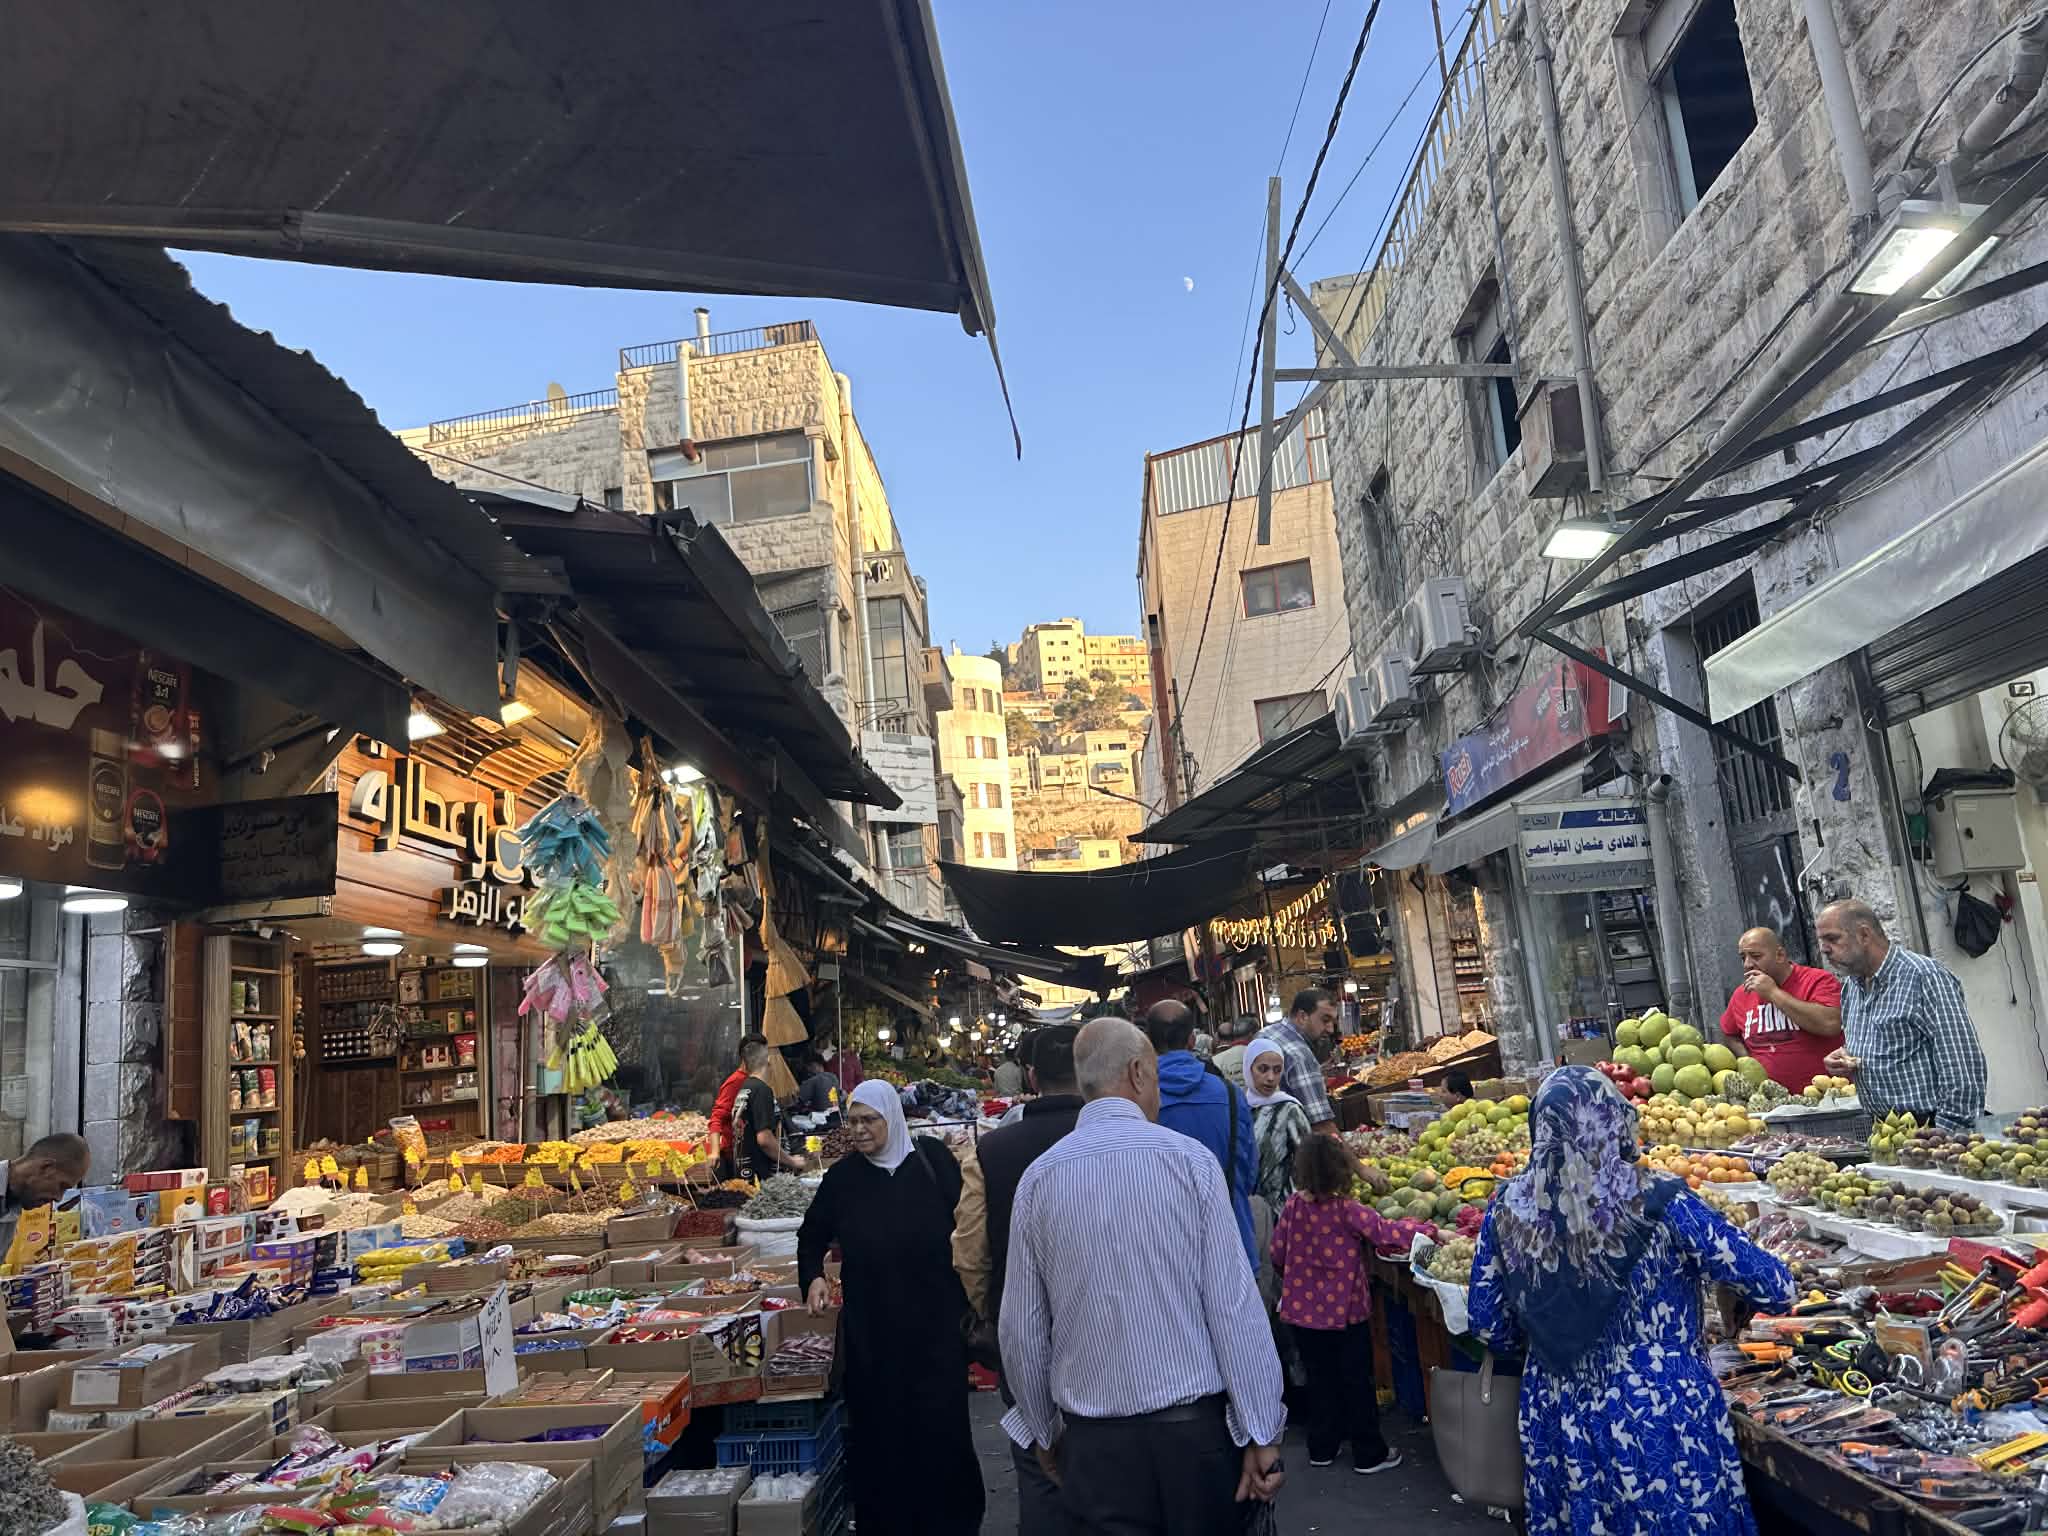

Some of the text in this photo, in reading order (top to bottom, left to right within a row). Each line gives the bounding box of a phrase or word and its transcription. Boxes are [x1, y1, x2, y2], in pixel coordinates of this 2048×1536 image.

[1597, 809, 1636, 825] بقالة
[1575, 835, 1604, 856] عثمان
[1608, 833, 1639, 857] الهادي
